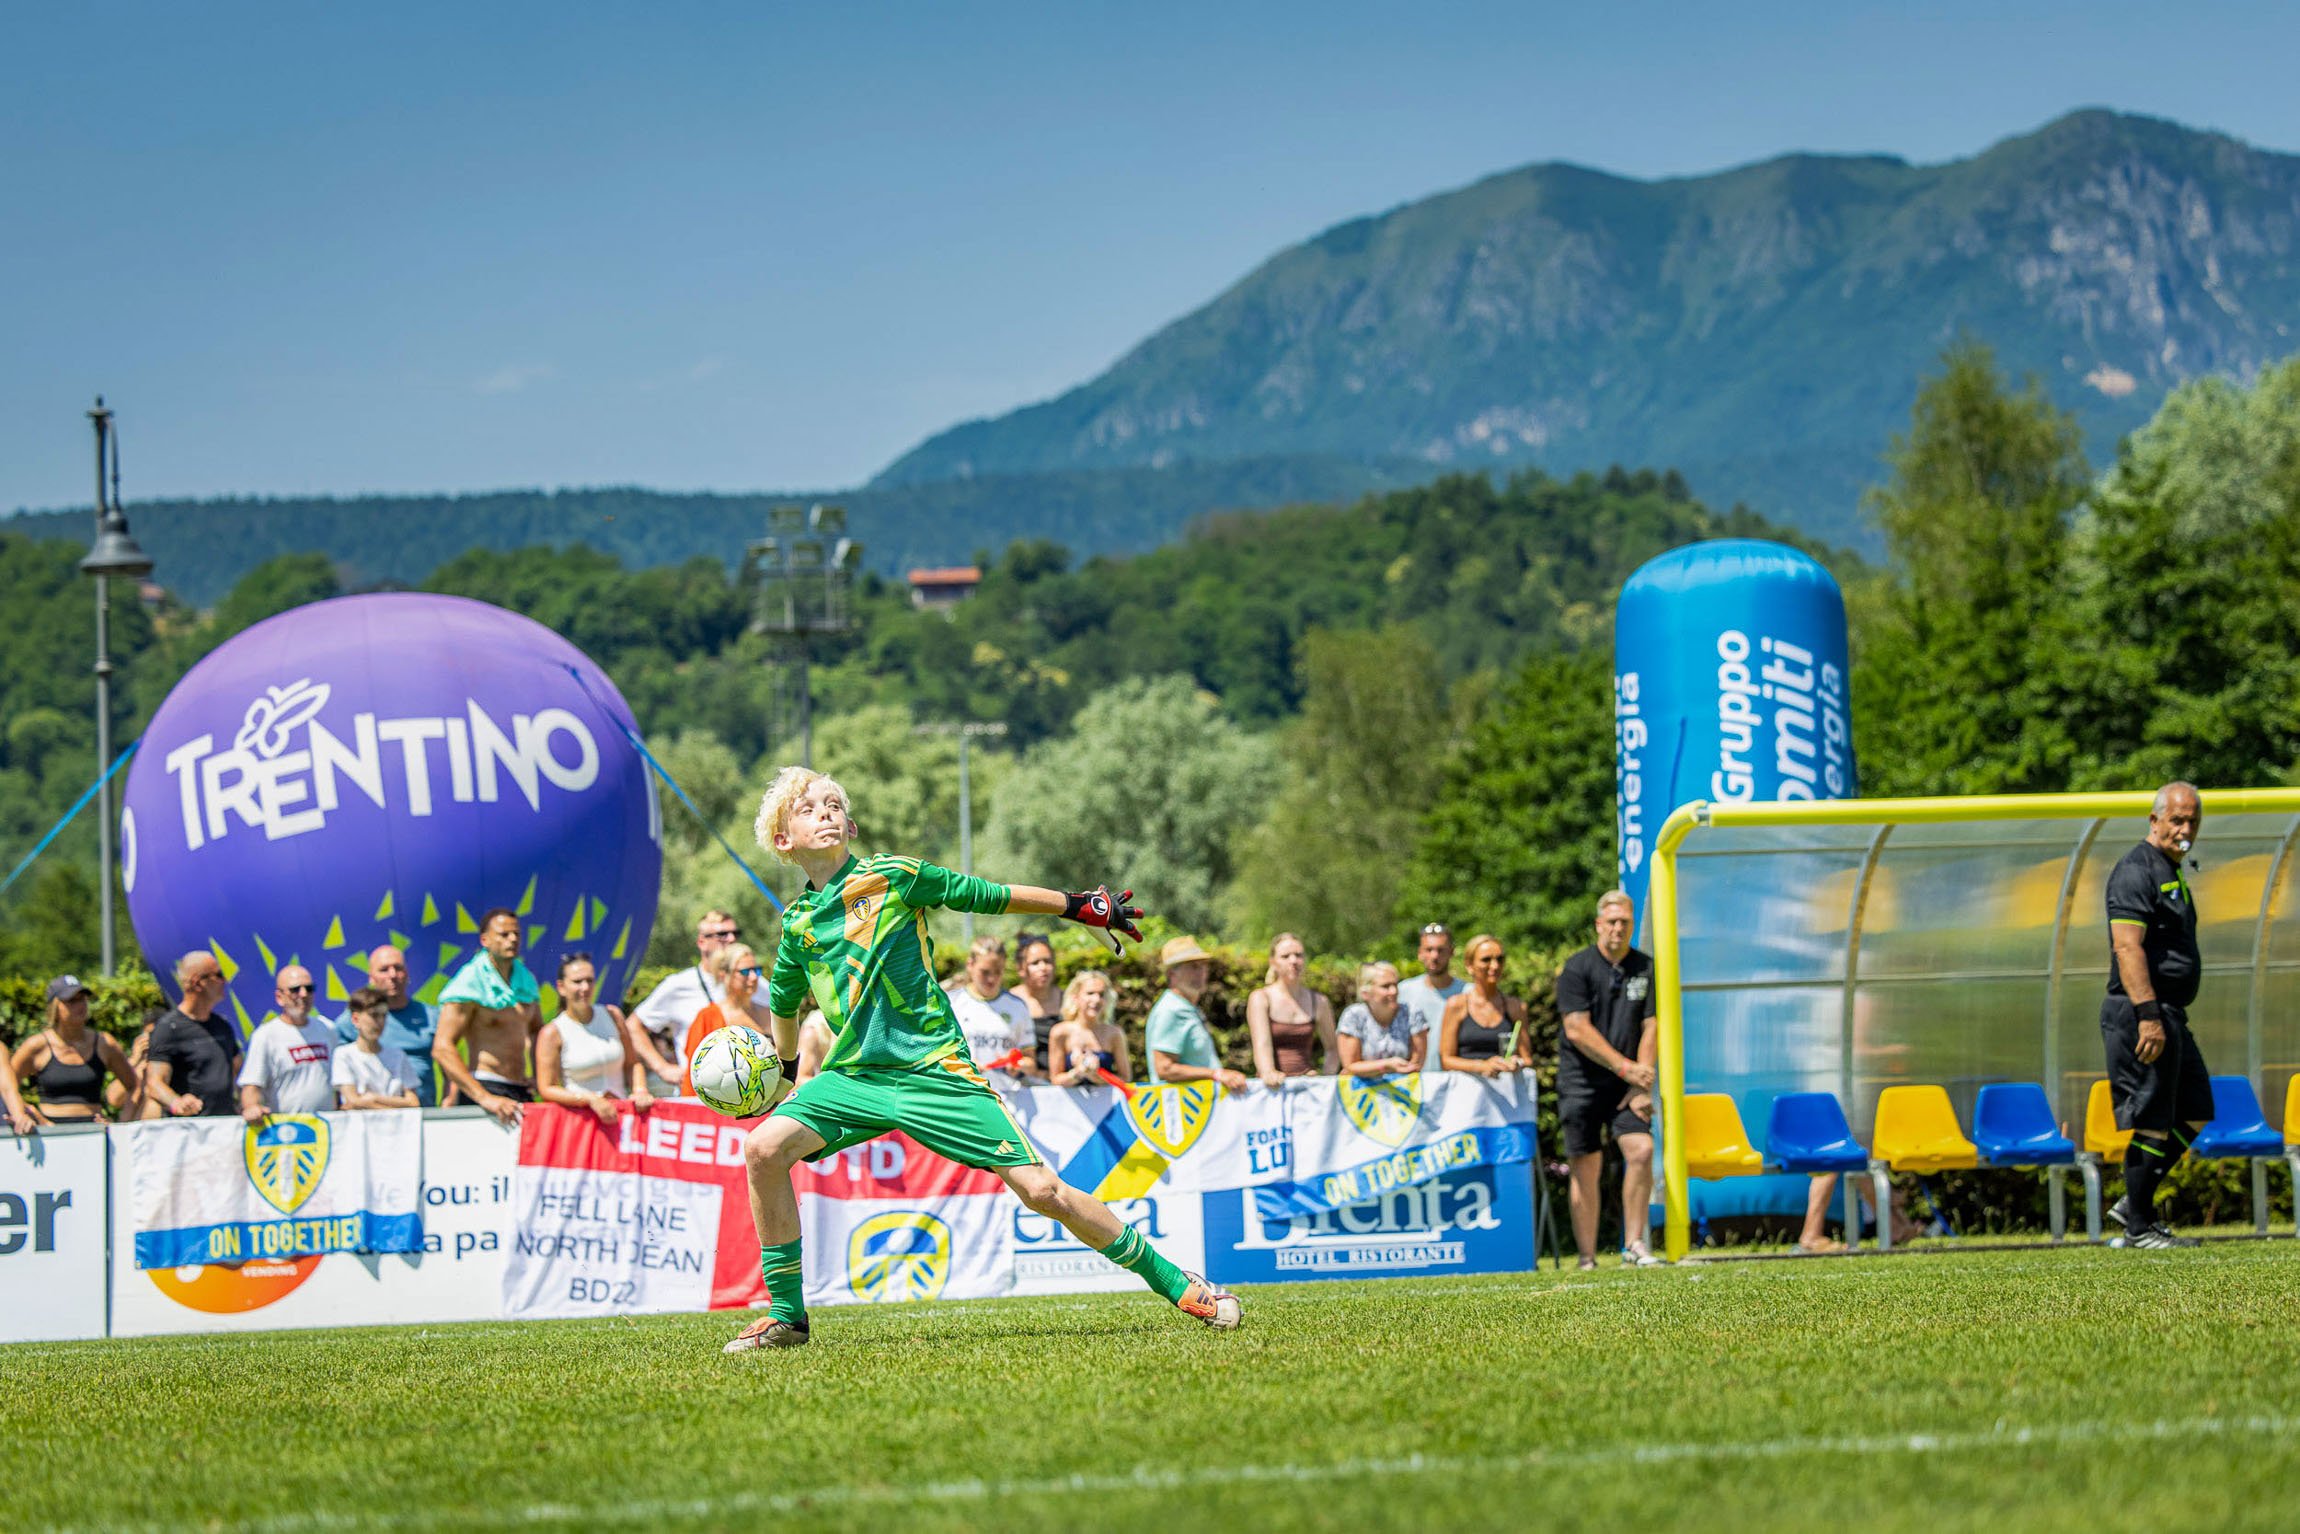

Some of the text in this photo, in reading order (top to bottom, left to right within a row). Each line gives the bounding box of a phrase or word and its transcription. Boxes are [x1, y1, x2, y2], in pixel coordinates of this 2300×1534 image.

[1711, 629, 1762, 803] Gruppo
[1817, 662, 1849, 801] ergia
[165, 697, 600, 851] TRENTINO
[1621, 672, 1648, 873] energia
[619, 1114, 746, 1168] LEED
[1323, 1132, 1482, 1207] ON TOGETHER
[419, 1180, 479, 1206] ou:
[540, 1194, 687, 1232] FELL LANE
[208, 1226, 241, 1259] ON
[516, 1231, 618, 1263] NORTH
[1275, 1243, 1464, 1267] HOTEL RISTORANTE
[242, 1262, 298, 1278] VENDING
